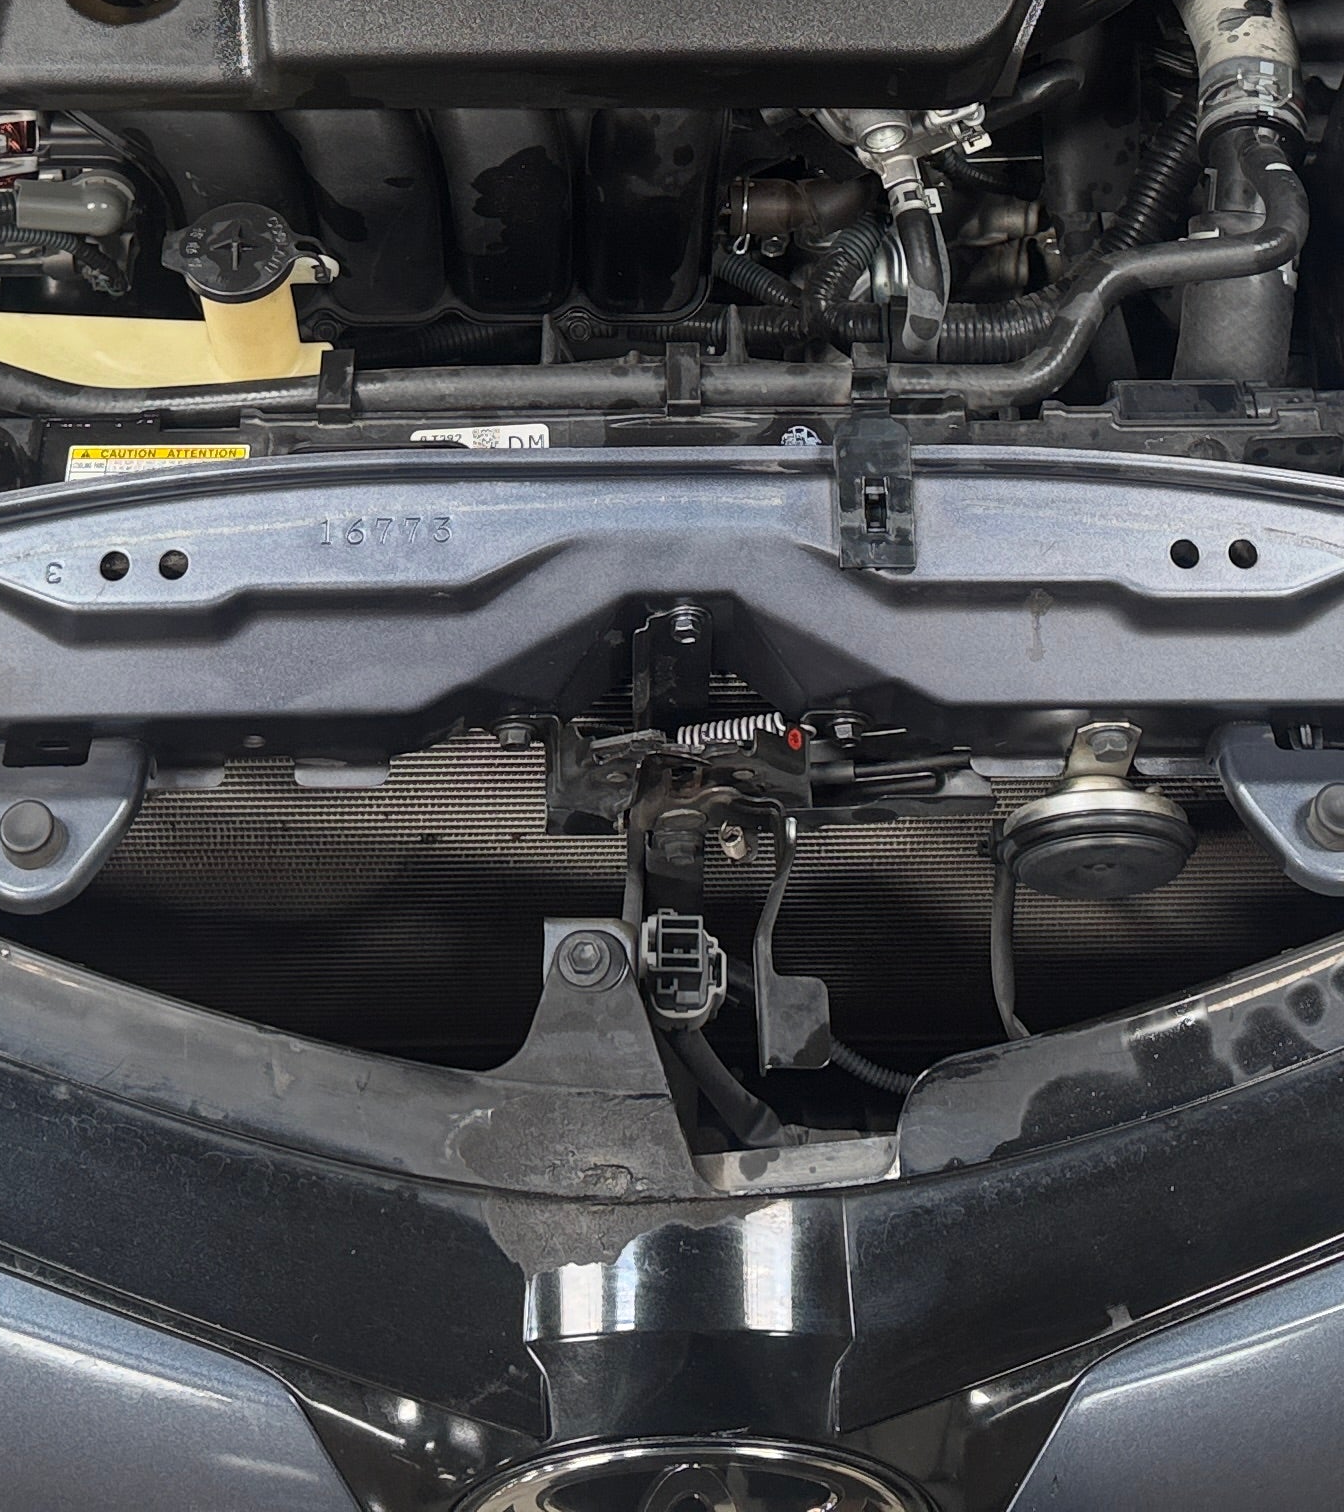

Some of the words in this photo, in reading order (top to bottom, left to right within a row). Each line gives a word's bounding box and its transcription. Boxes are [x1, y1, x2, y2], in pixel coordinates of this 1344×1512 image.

[100, 449, 156, 458] CAUTION
[167, 449, 237, 458] ATTENTION
[320, 516, 453, 545] 16773
